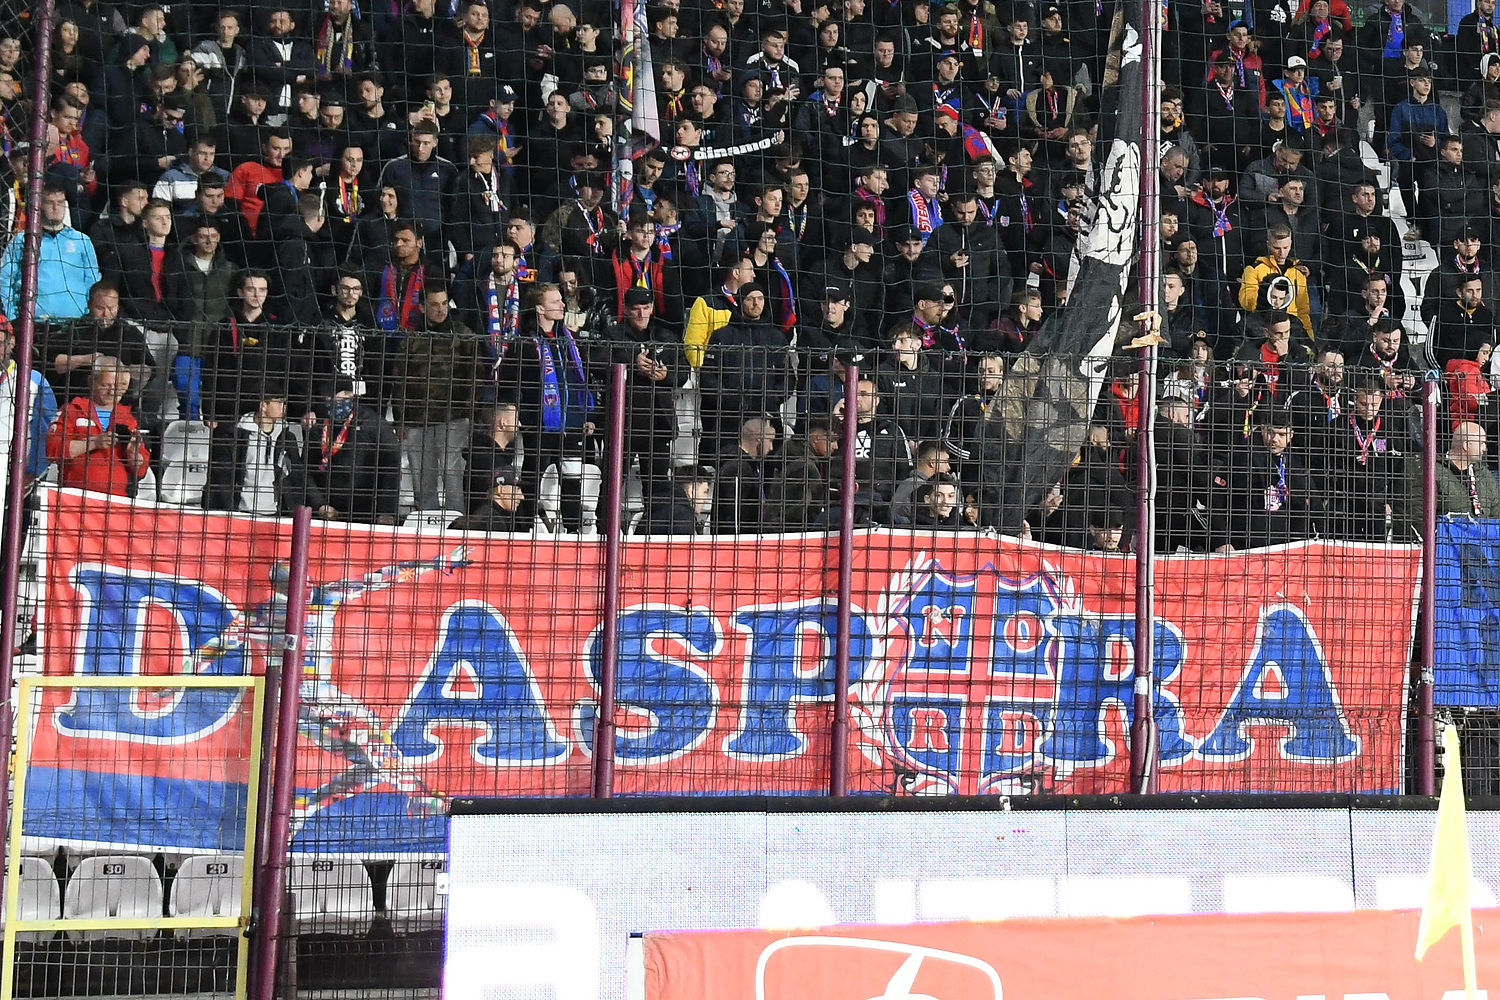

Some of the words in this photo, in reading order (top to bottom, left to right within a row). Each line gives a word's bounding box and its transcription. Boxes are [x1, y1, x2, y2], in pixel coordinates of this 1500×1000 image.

[694, 138, 771, 160] dinamo
[105, 864, 122, 875] 30
[208, 864, 226, 875] 29
